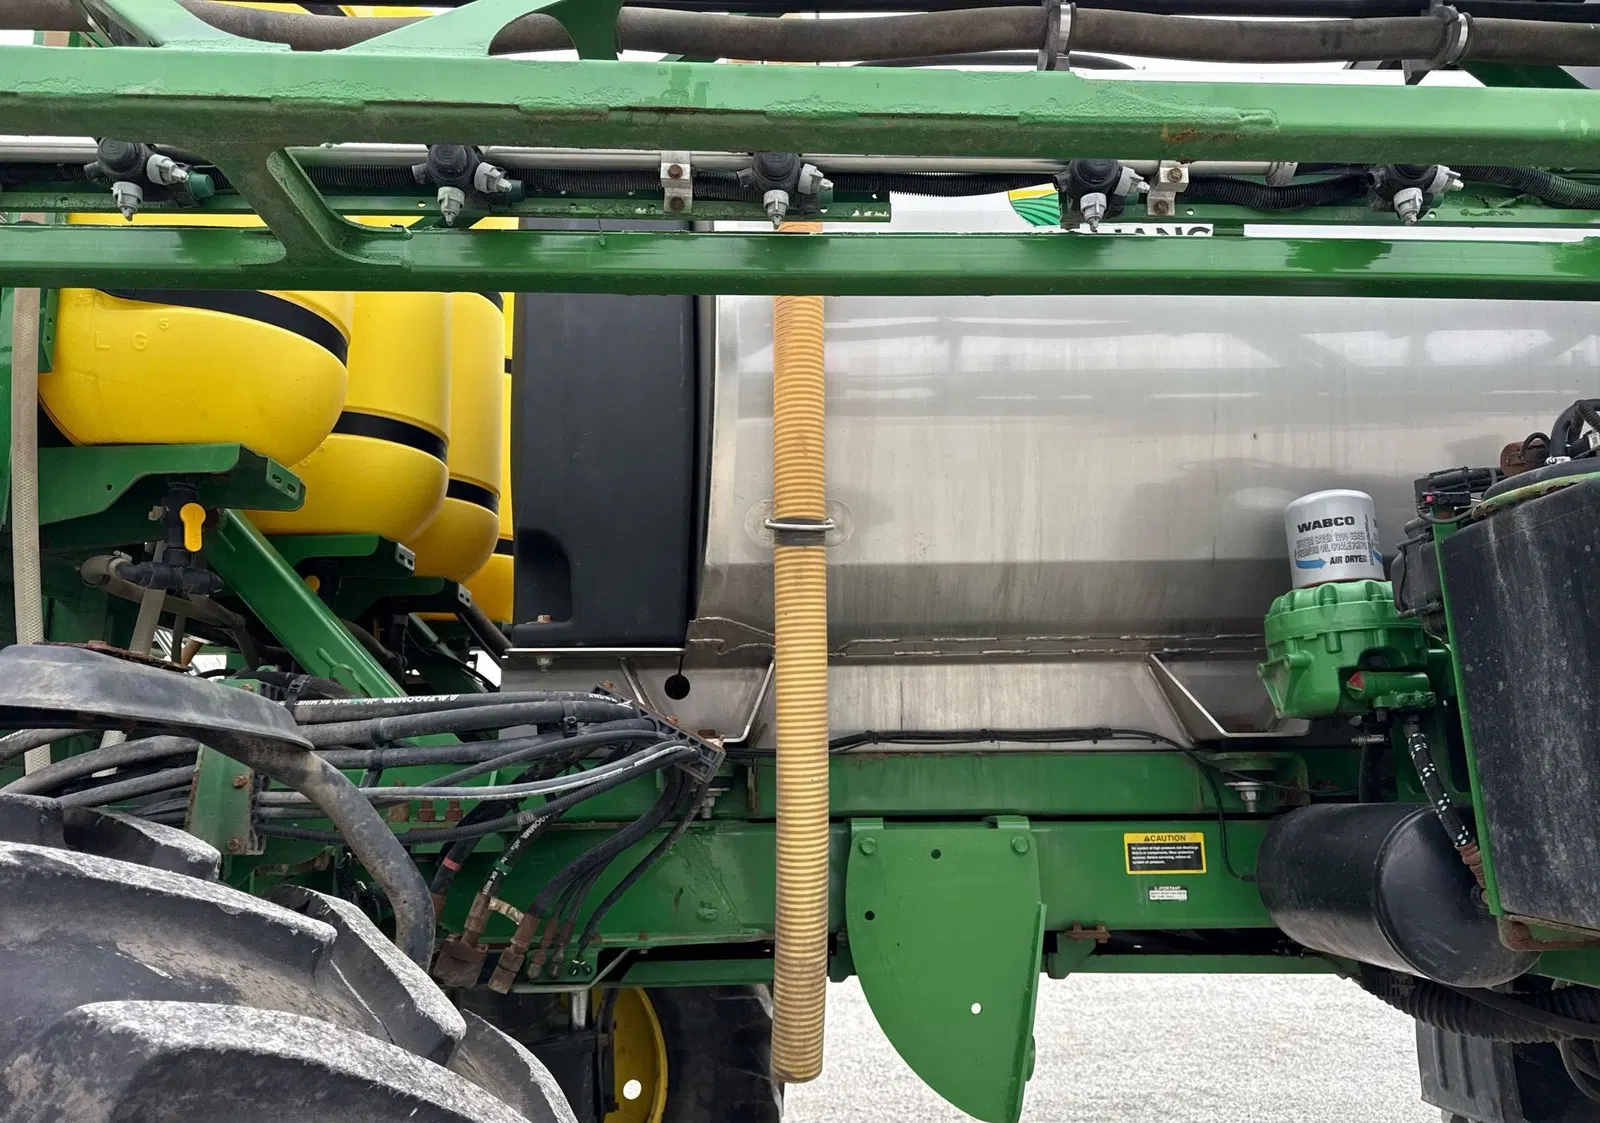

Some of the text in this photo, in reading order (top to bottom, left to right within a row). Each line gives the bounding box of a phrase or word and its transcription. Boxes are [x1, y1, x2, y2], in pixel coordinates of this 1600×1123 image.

[1297, 516, 1355, 533] WABCO
[1330, 555, 1367, 565] AIR DRYER
[1150, 834, 1186, 842] CAUTION
